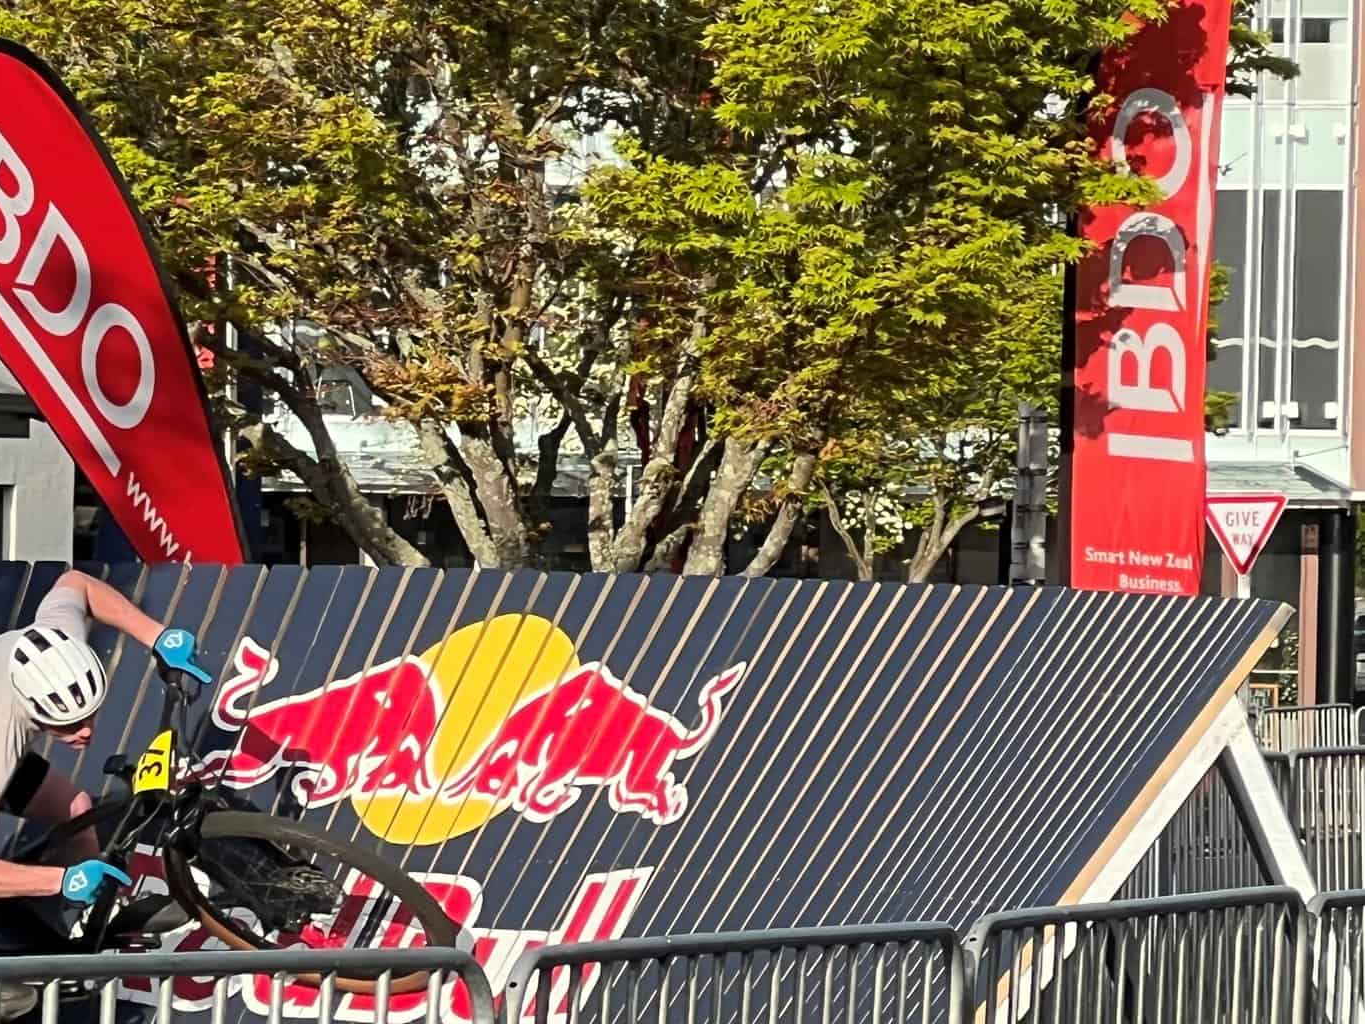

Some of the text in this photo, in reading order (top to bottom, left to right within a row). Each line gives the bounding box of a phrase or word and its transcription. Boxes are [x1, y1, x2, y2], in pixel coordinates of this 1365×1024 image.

[1108, 88, 1191, 413] BDO
[1225, 511, 1259, 527] GIVE
[1231, 533, 1254, 545] WAY
[1085, 546, 1125, 566] Smart
[1128, 550, 1162, 567] New
